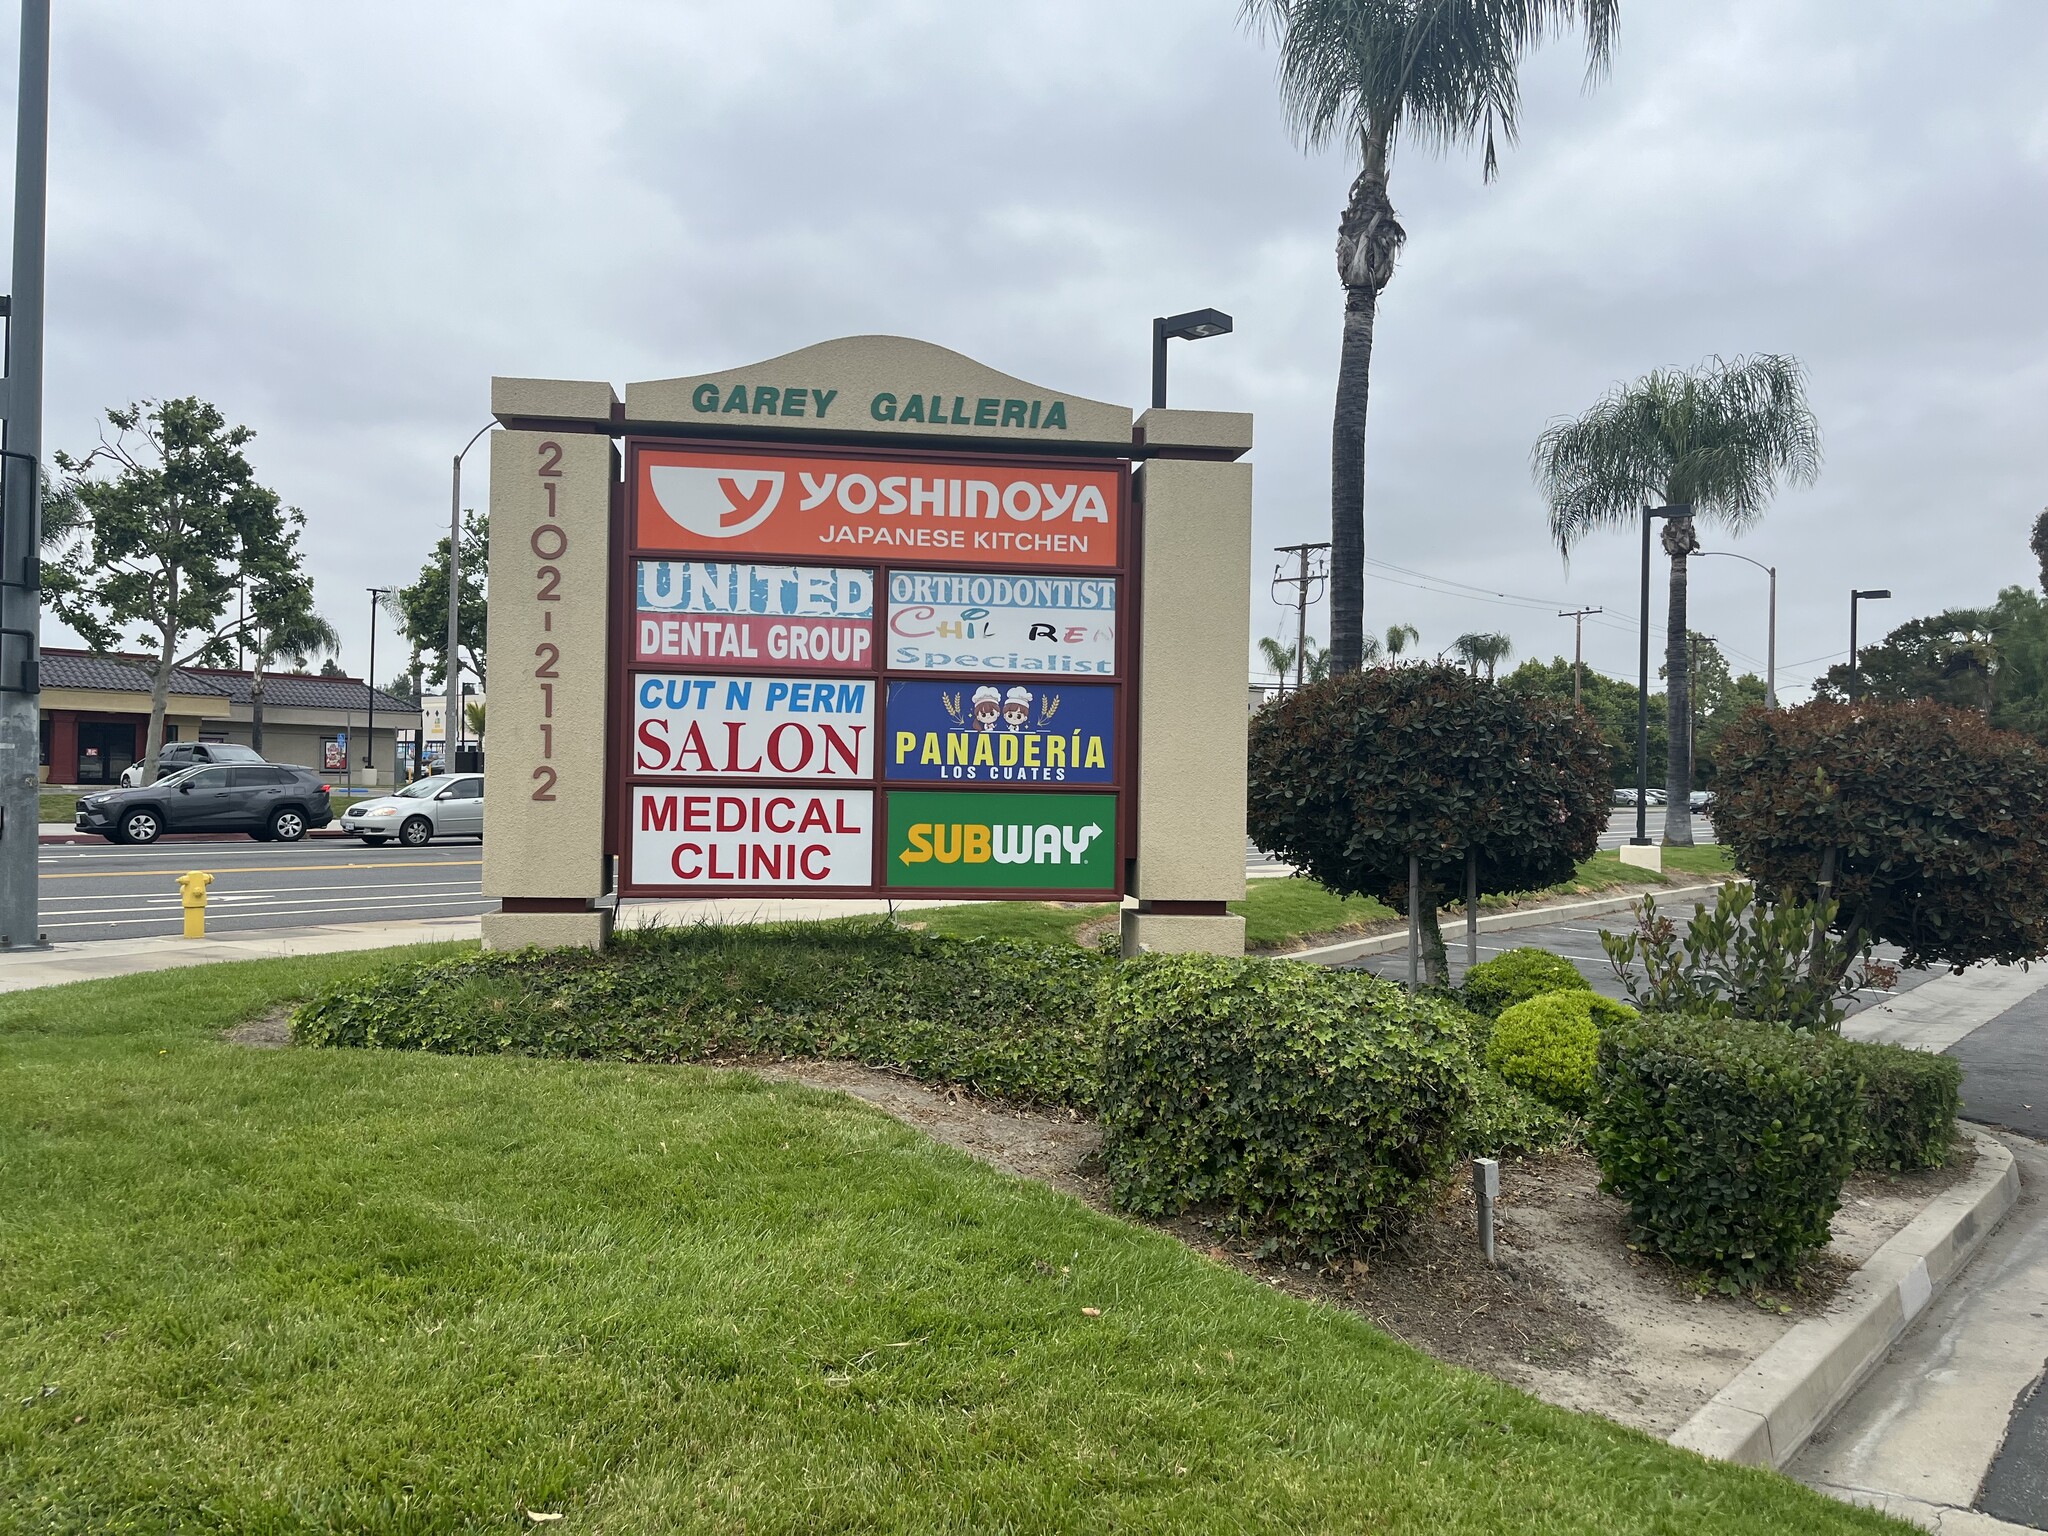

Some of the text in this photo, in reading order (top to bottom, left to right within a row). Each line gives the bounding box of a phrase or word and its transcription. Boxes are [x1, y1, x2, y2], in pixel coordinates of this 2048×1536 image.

[692, 383, 1068, 429] GAREY GALLERIA
[799, 472, 1109, 523] YOSHINOYA
[818, 525, 1089, 553] JAPANESE KITCHEN
[642, 561, 873, 614] UNITED
[891, 575, 1116, 609] ORTHODONTIST
[530, 441, 568, 801] 2102-2112
[640, 620, 871, 662] DENTAL GROUP
[896, 647, 1112, 674] Specialist
[639, 679, 866, 714] CUT N PERM
[637, 718, 867, 775] SALON
[895, 729, 1106, 769] PANADERÍA
[940, 765, 1066, 781] LOS CUATES
[641, 795, 861, 834] MEDICAL
[671, 842, 832, 881] CLINIC
[899, 821, 1103, 867] SUBWAY
